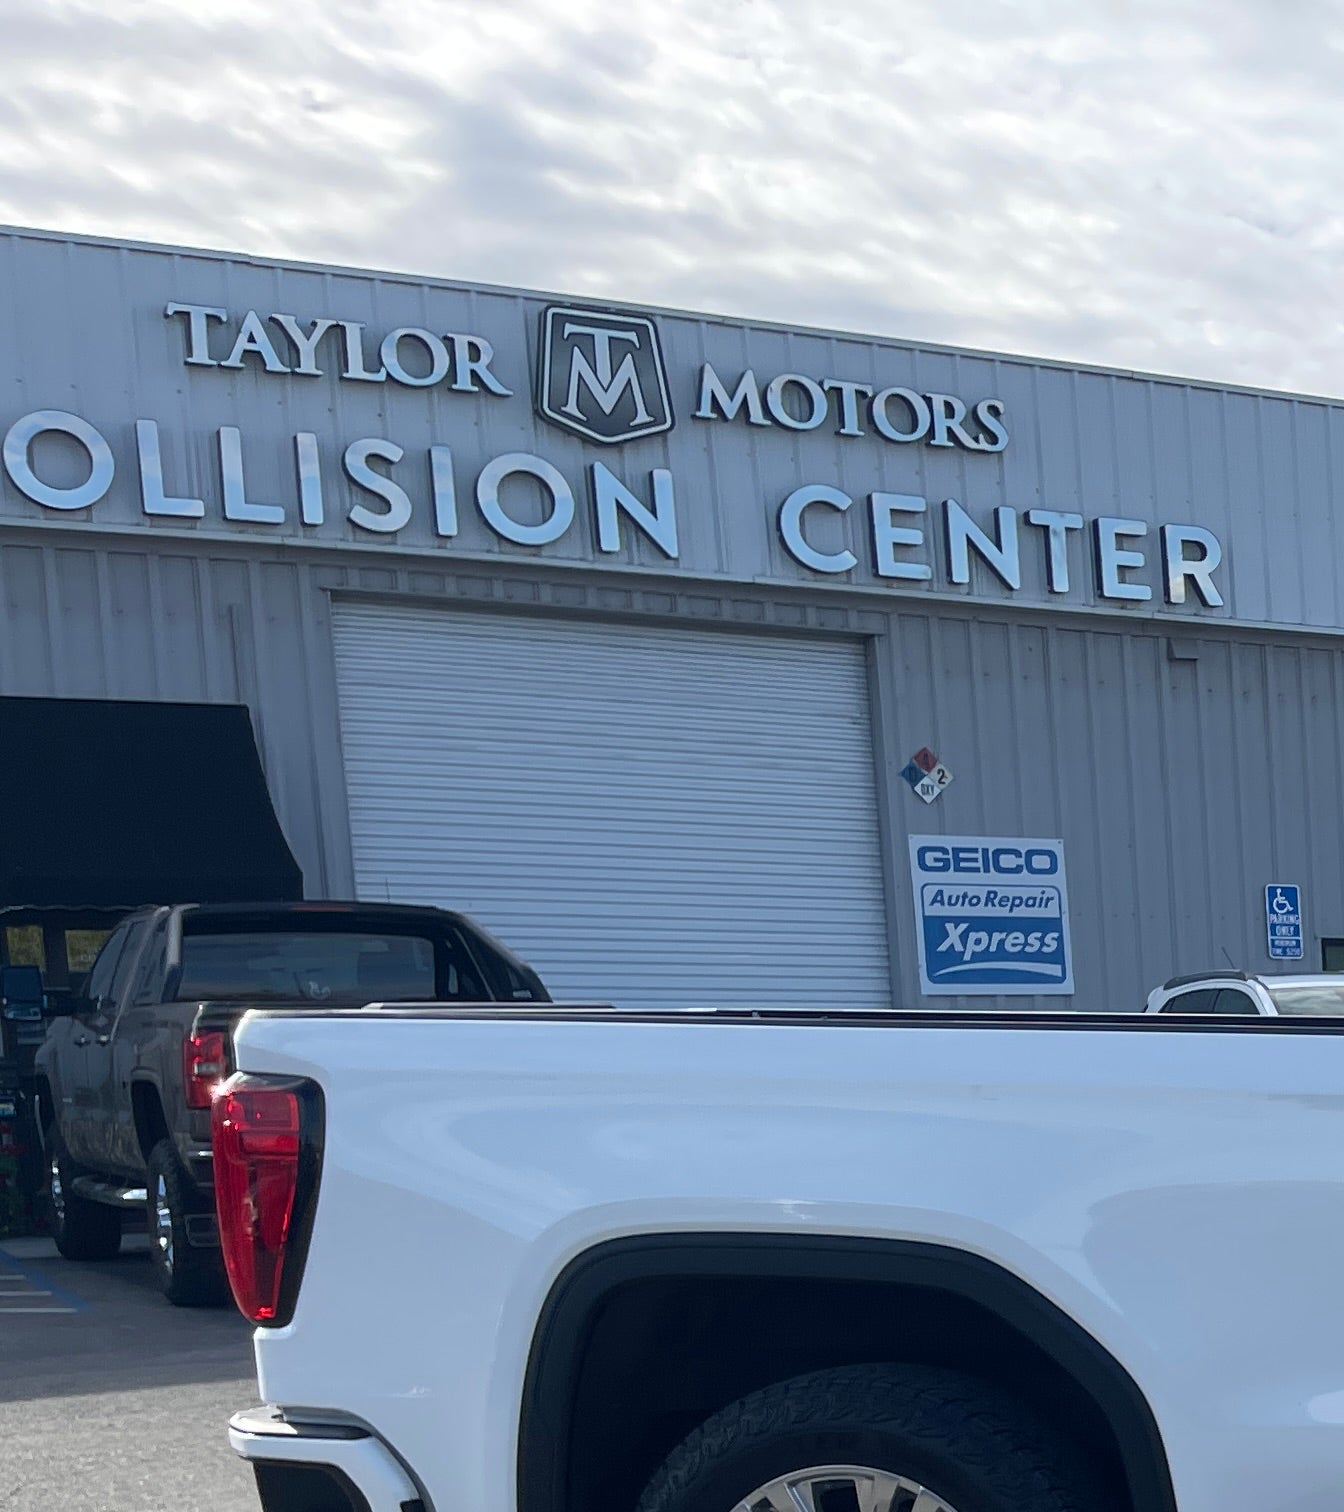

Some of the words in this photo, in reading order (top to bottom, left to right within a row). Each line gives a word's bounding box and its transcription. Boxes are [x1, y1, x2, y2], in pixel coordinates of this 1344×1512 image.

[165, 301, 513, 396] TAYLOR
[695, 362, 1010, 454] MOTORS
[2, 408, 680, 560] OLLISION
[777, 484, 1225, 607] CENTER
[936, 768, 946, 785] 2
[917, 845, 1058, 875] GEICO
[929, 889, 982, 907] Auto
[983, 890, 1055, 913] Repair
[936, 922, 1060, 961] Xpress
